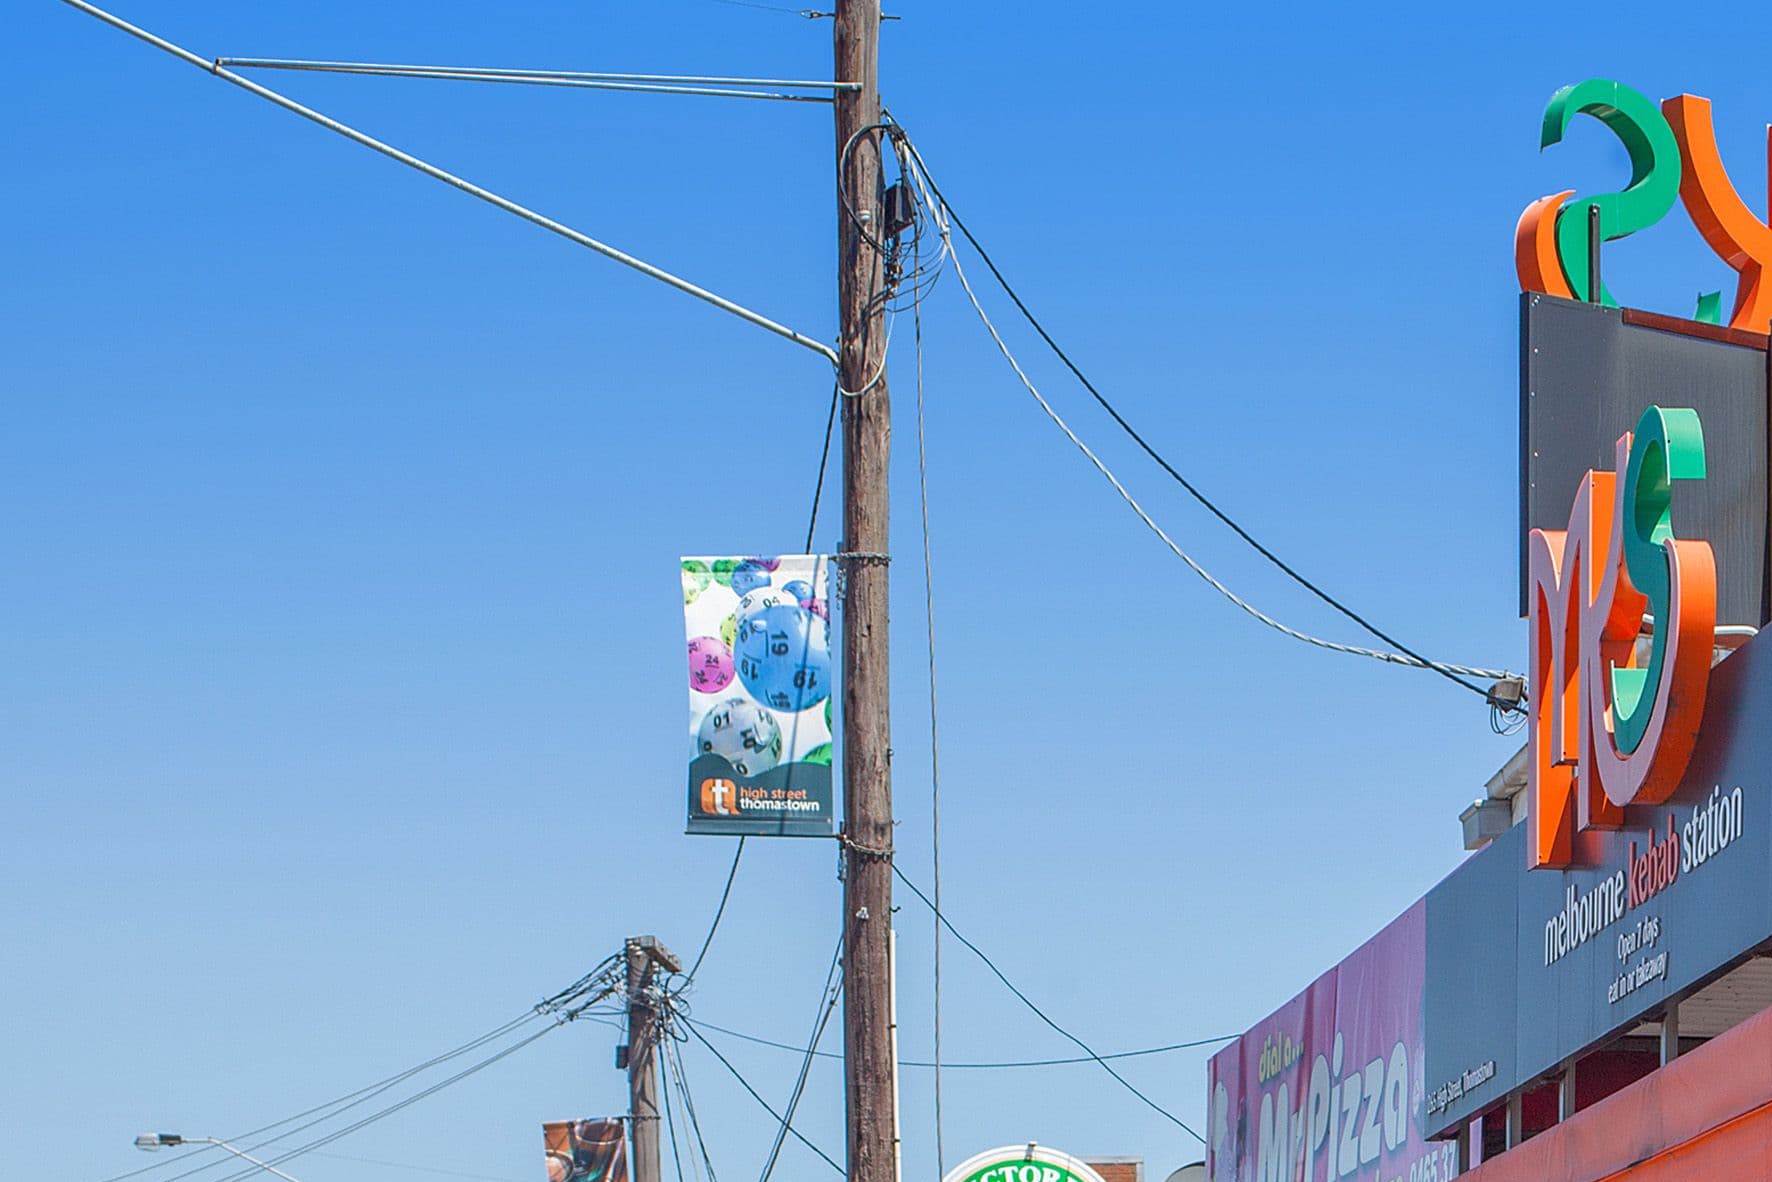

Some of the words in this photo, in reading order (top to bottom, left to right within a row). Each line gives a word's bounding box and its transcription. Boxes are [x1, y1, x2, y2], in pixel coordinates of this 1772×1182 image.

[1528, 404, 1715, 870] MKS
[740, 786, 768, 800] high
[771, 787, 807, 799] street
[740, 798, 820, 812] thomastown
[1545, 869, 1626, 966] melbourne
[1628, 813, 1681, 909] kebab
[1682, 785, 1744, 874] station
[1617, 932, 1636, 965] Open
[1644, 916, 1660, 948] days
[1636, 951, 1668, 990] takeaway
[1258, 1031, 1282, 1085] dial
